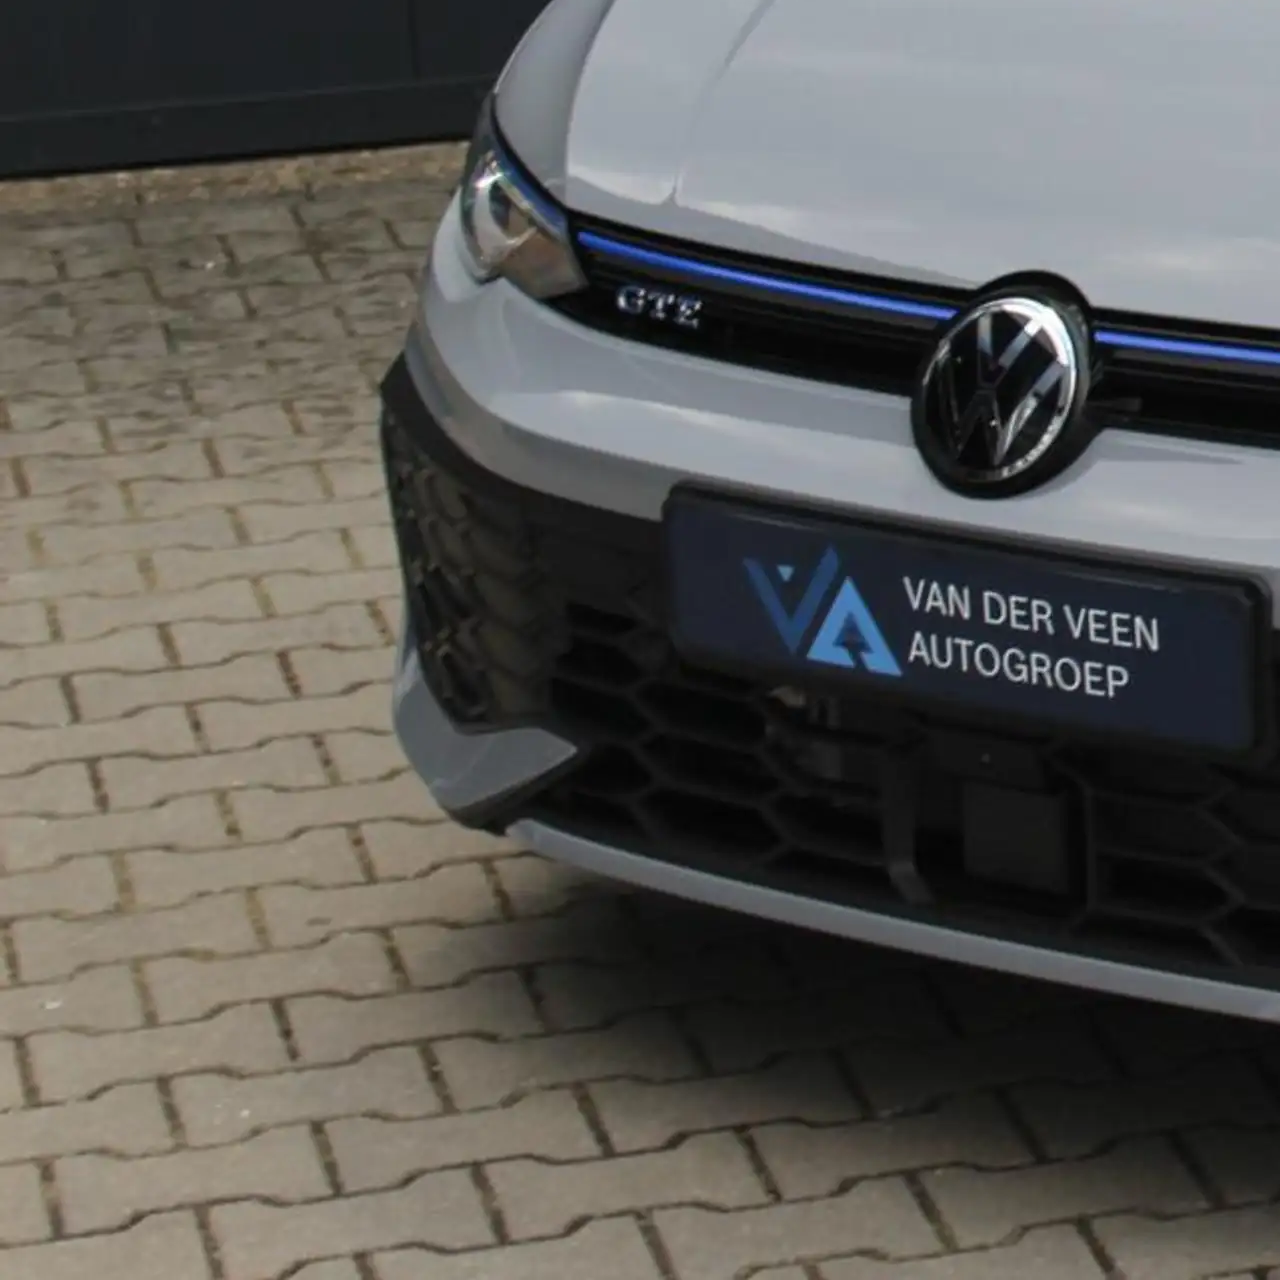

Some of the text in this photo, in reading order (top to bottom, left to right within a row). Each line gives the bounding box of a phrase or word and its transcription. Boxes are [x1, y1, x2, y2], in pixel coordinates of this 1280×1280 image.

[617, 286, 702, 329] GTE
[903, 576, 1159, 652] VAN DER VEEN
[907, 631, 1129, 698] AUTOGROEP
